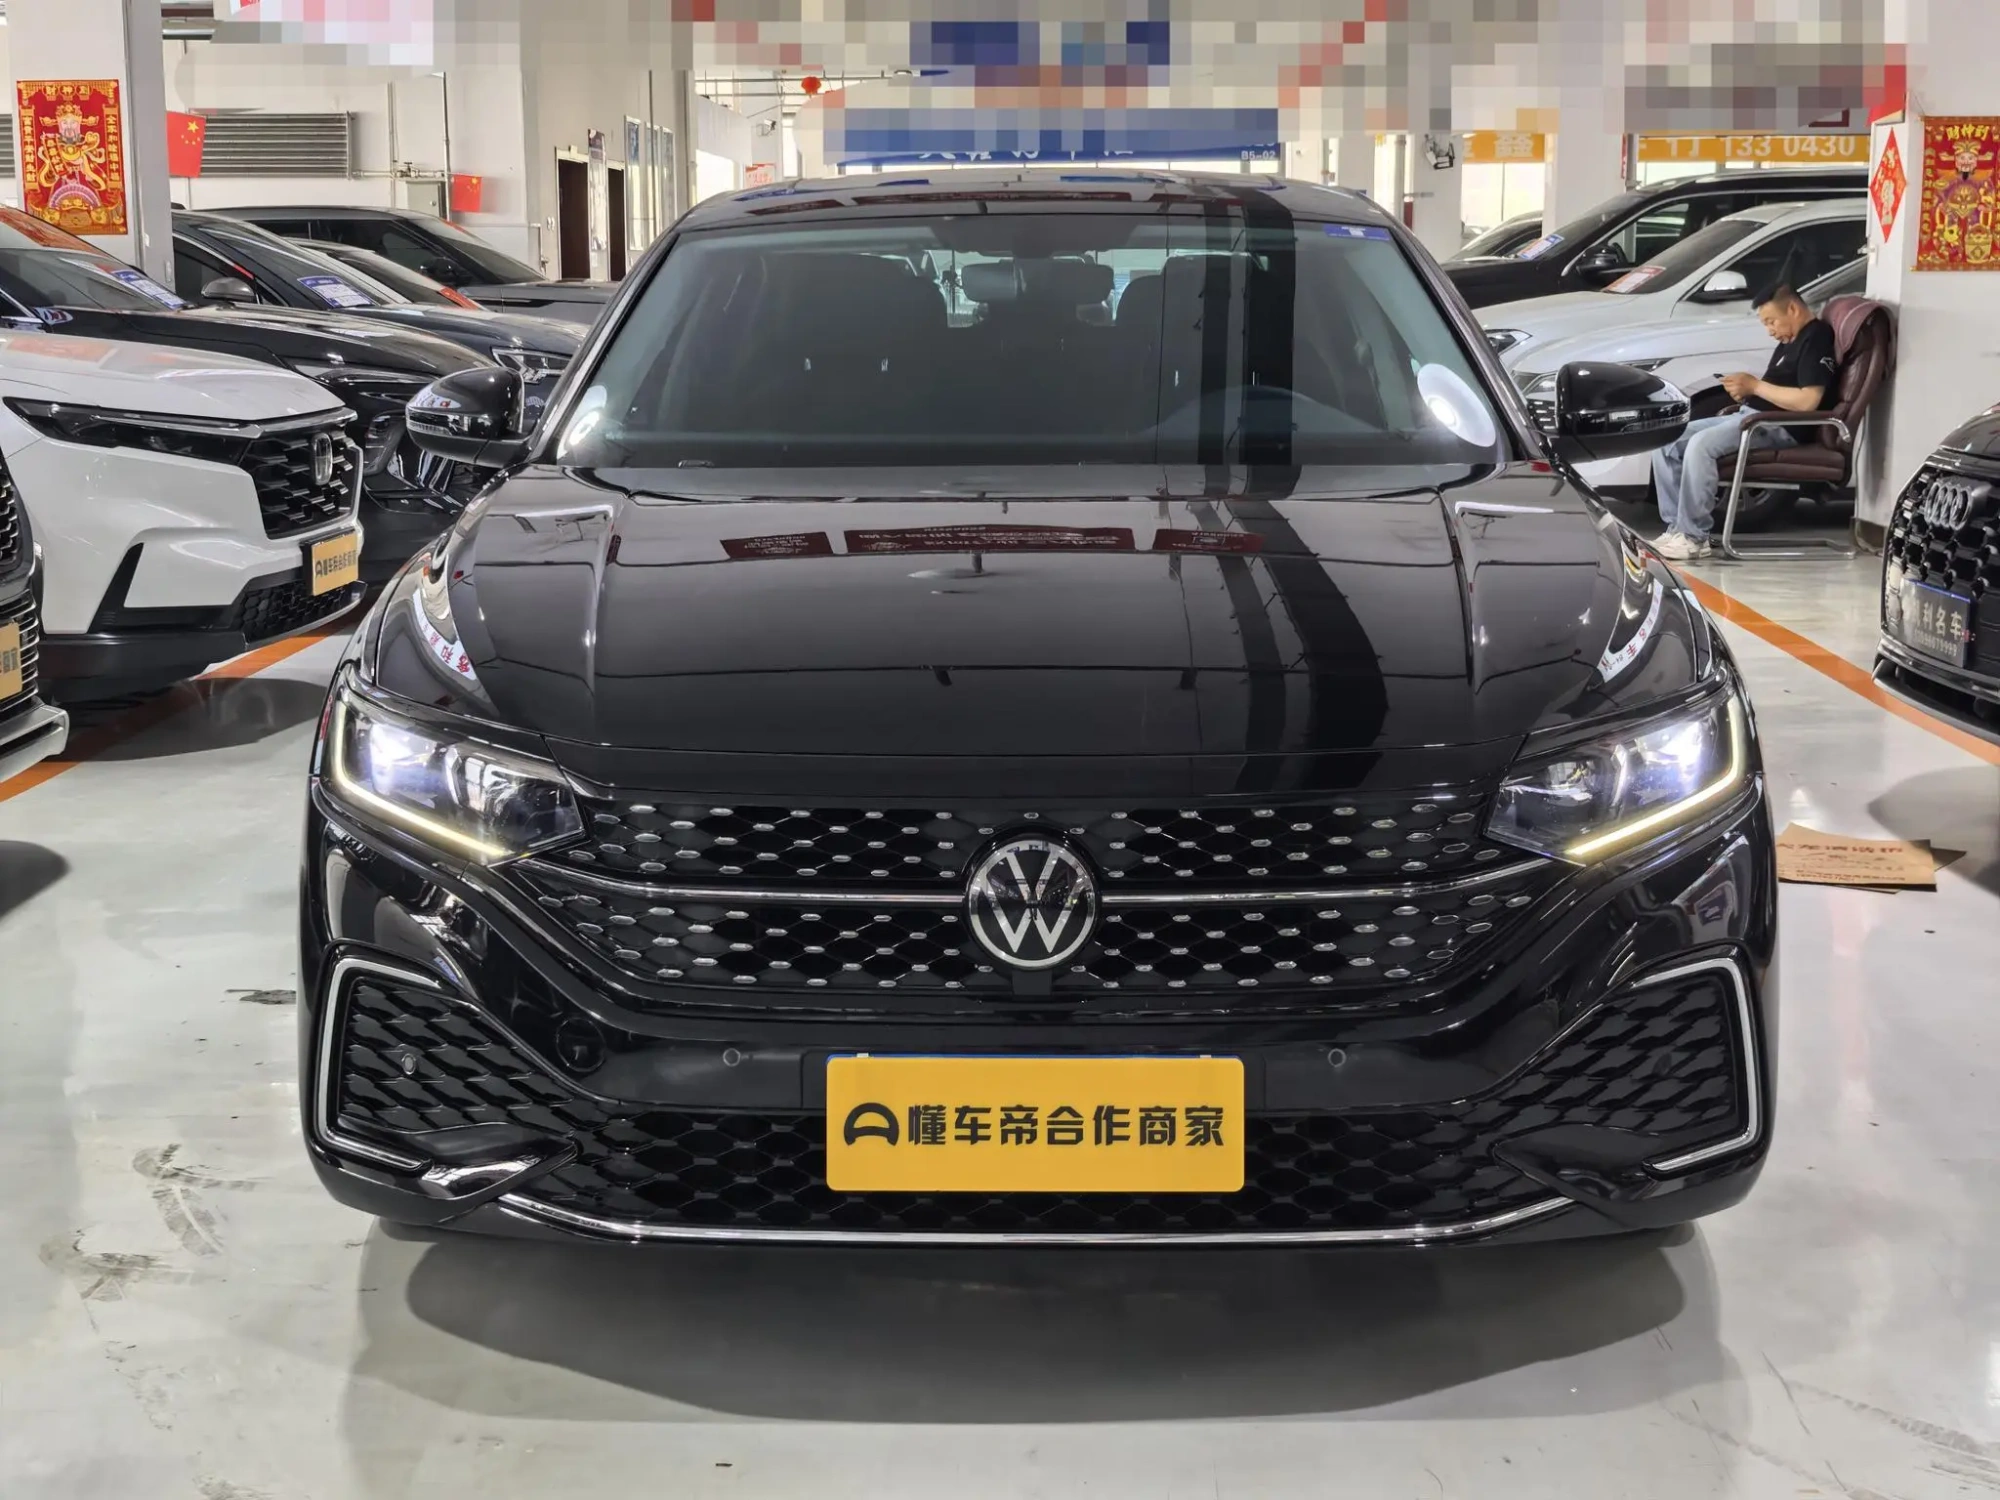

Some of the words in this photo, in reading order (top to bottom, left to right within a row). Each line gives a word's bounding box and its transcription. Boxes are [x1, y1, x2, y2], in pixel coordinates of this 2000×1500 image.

[908, 1104, 1224, 1147] 懂车帝合作商家
